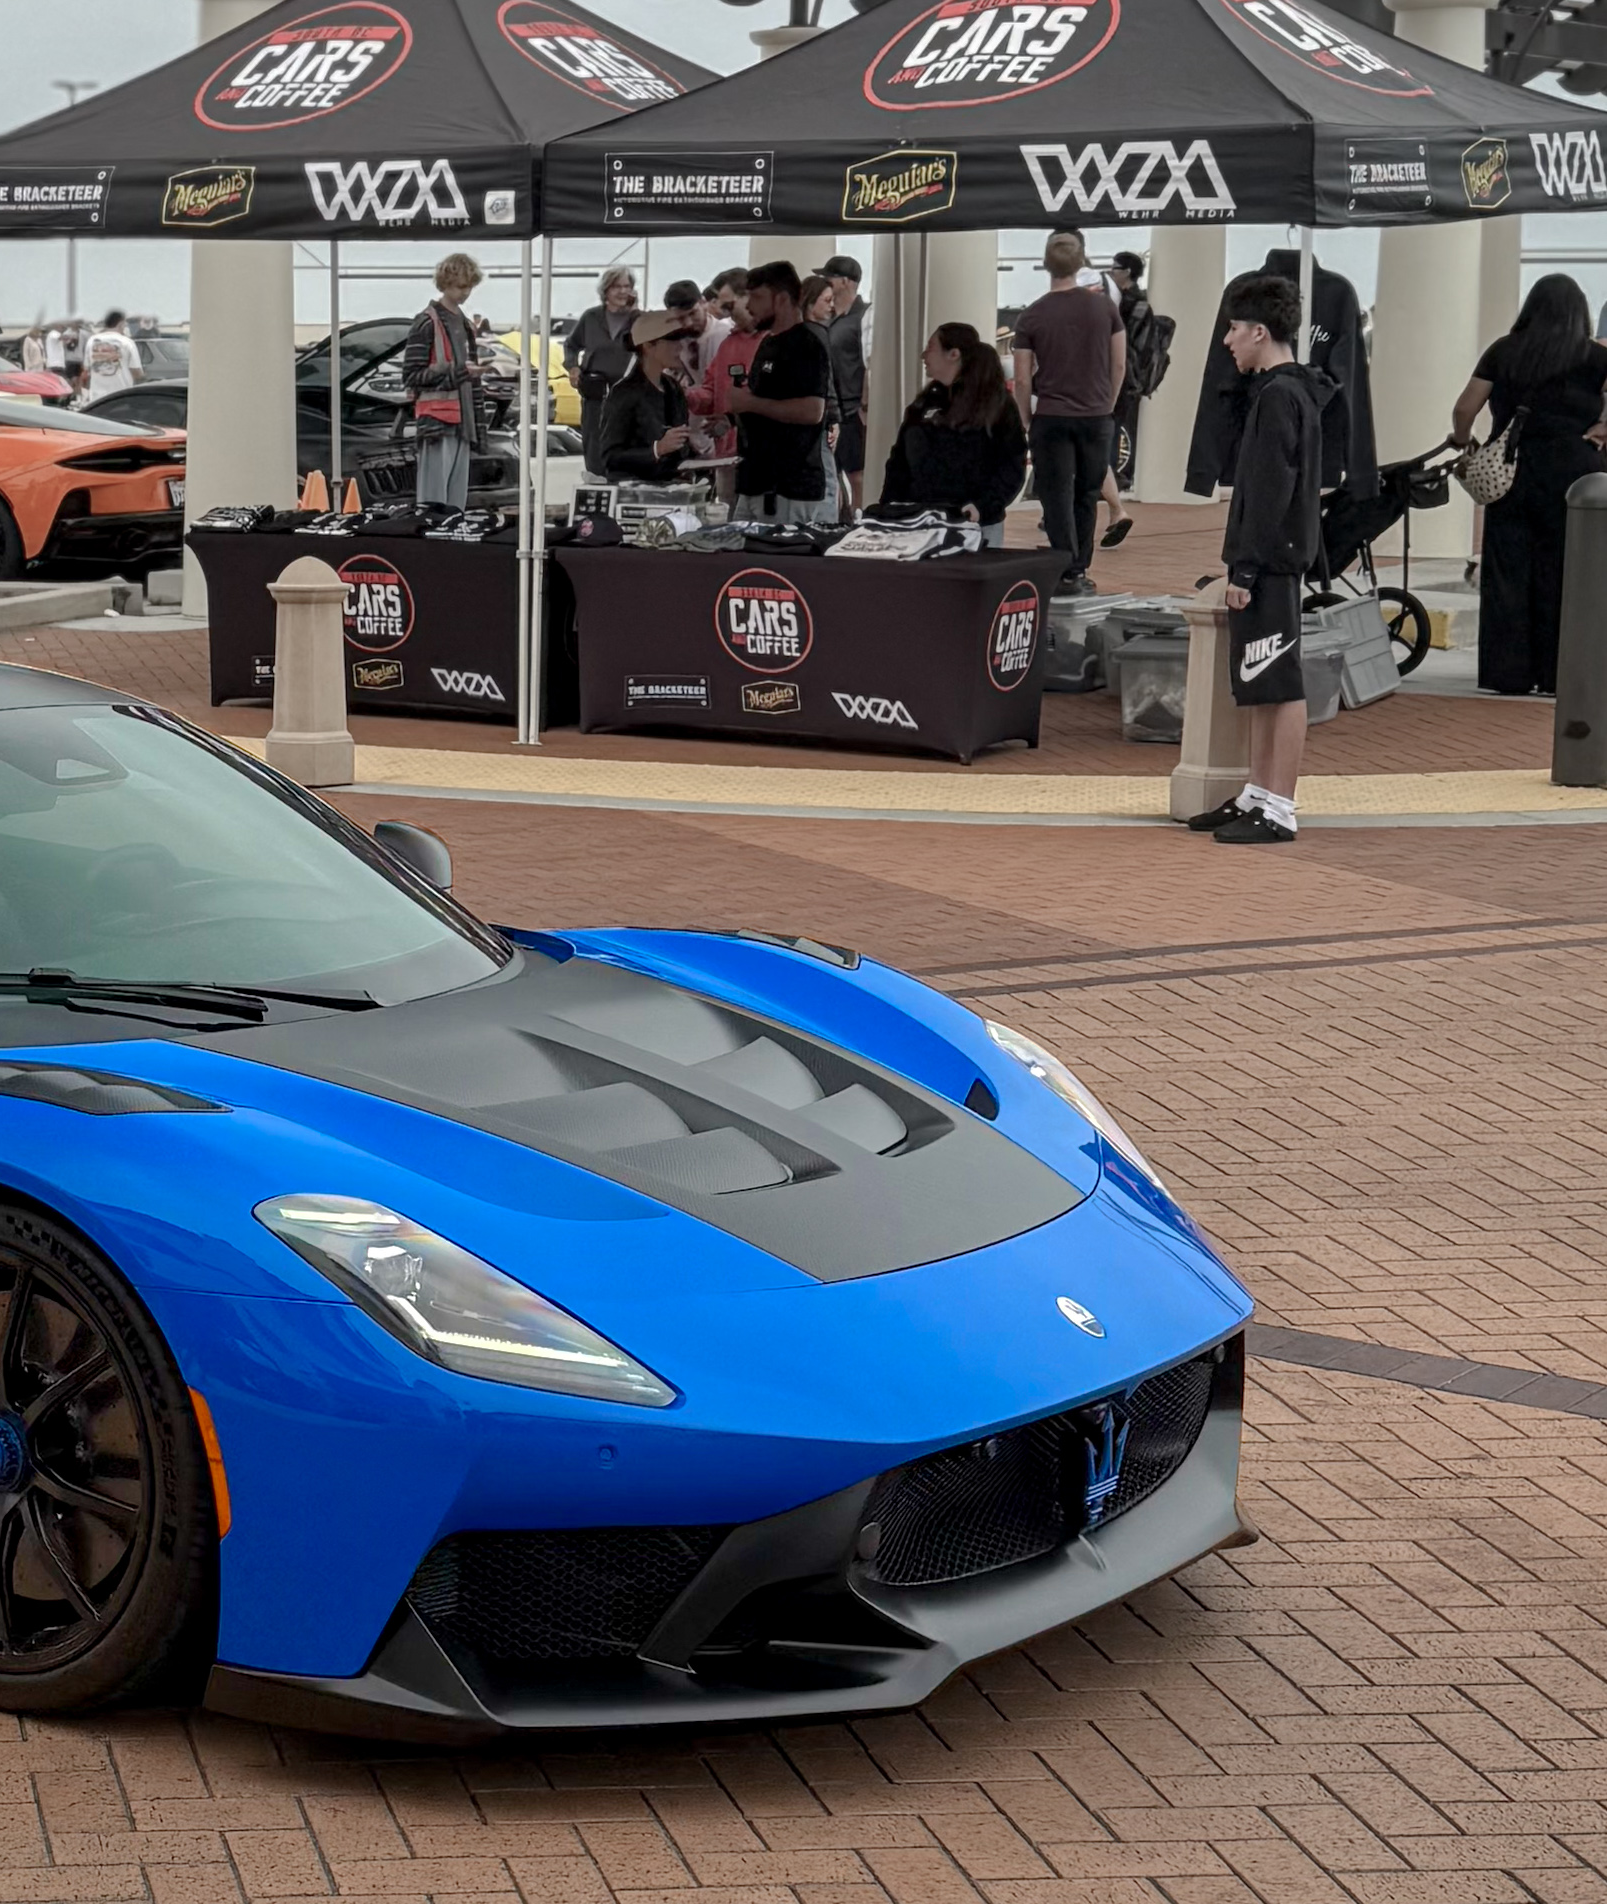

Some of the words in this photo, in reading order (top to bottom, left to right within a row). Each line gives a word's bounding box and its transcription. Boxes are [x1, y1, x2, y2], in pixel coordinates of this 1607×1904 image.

[902, 6, 1088, 68] CARS
[230, 40, 385, 86] CARS
[528, 36, 656, 78] CARS
[914, 55, 1054, 88] COFFEE
[234, 83, 351, 108] COFFEE
[14, 185, 103, 201] BRACKETEER
[613, 176, 644, 194] THE
[652, 175, 764, 194] BRACKETEER
[1185, 209, 1235, 218] MEDIA
[342, 583, 402, 617] CARS
[357, 617, 404, 636] COFFEE
[729, 598, 798, 637] CARS
[996, 610, 1034, 653] CARS
[747, 635, 801, 656] COFFEE
[1001, 648, 1029, 672] COFFEE
[1245, 632, 1283, 665] NIKE
